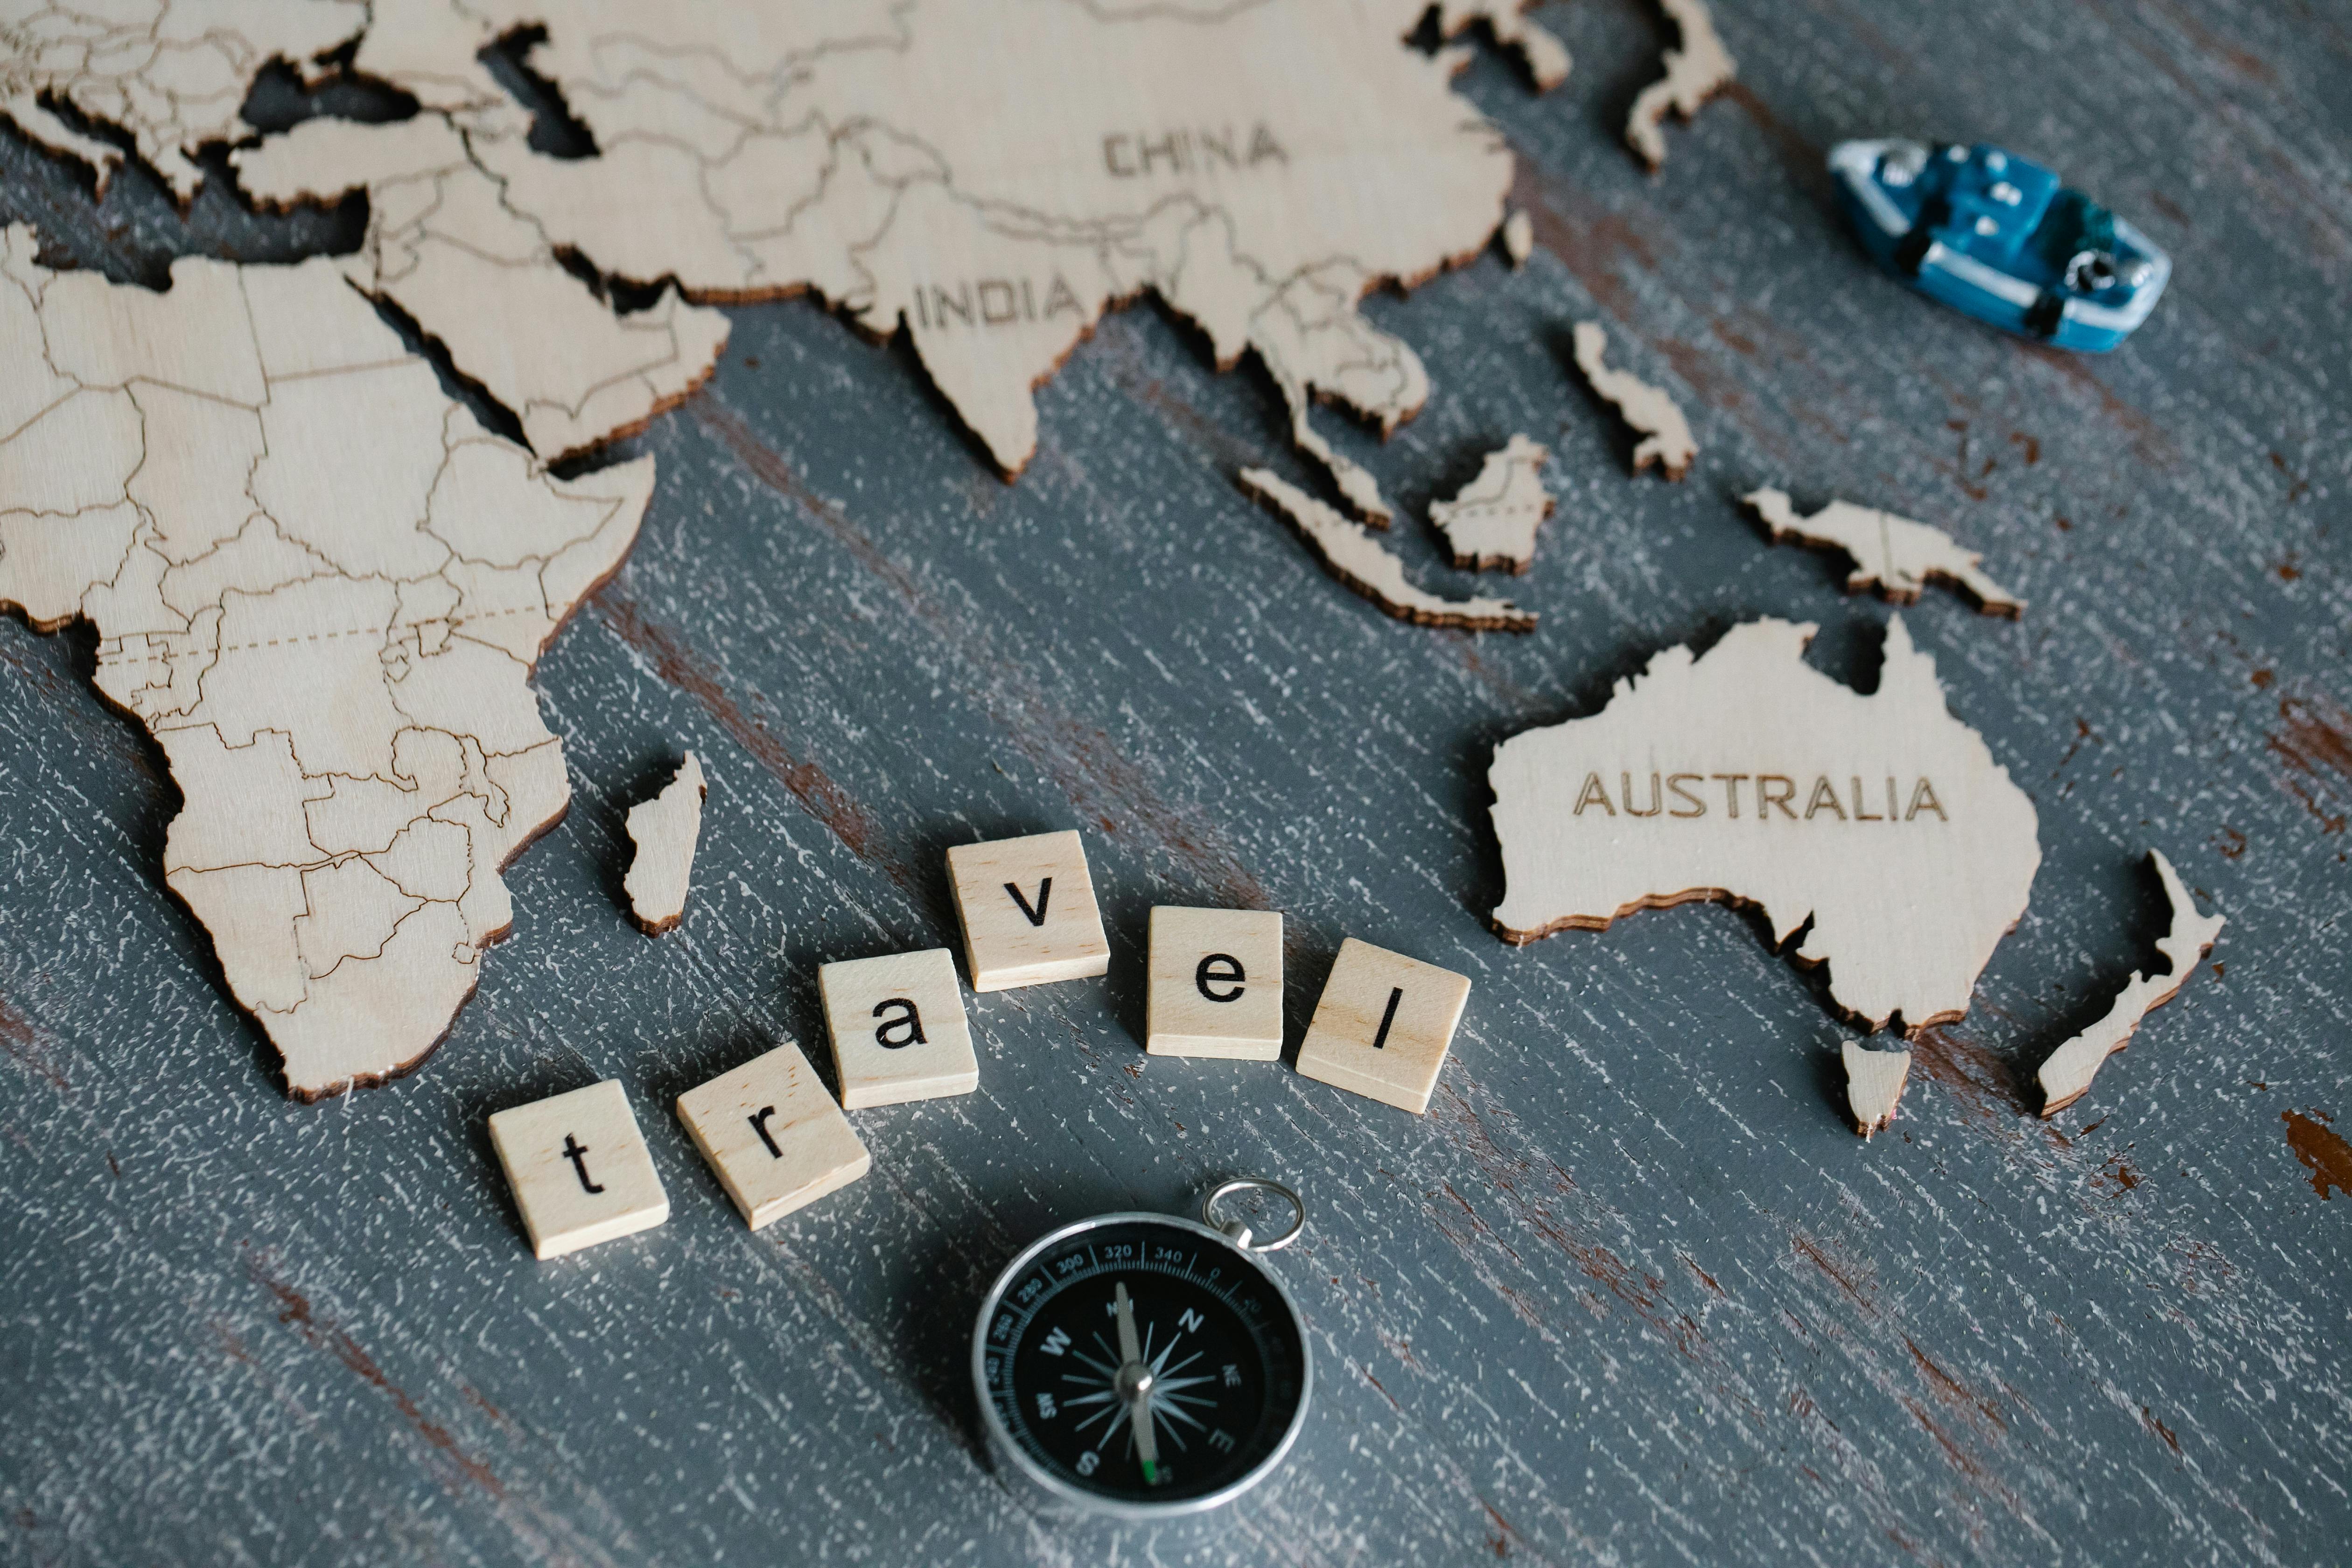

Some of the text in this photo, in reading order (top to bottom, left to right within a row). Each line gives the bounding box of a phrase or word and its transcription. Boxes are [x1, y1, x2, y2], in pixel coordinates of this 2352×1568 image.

[1101, 119, 1290, 178] CHINA
[914, 268, 1085, 329] INDIA
[1572, 770, 1949, 821] AUSTRALIA
[1056, 1253, 1084, 1274] 300
[1104, 1244, 1133, 1260] 320
[1154, 1246, 1183, 1264] 340
[1178, 1307, 1204, 1334] N
[1040, 1326, 1072, 1358] W
[1221, 1363, 1242, 1388] NE
[1035, 1392, 1057, 1420] SW
[1208, 1427, 1236, 1455] E
[1075, 1450, 1100, 1477] S
